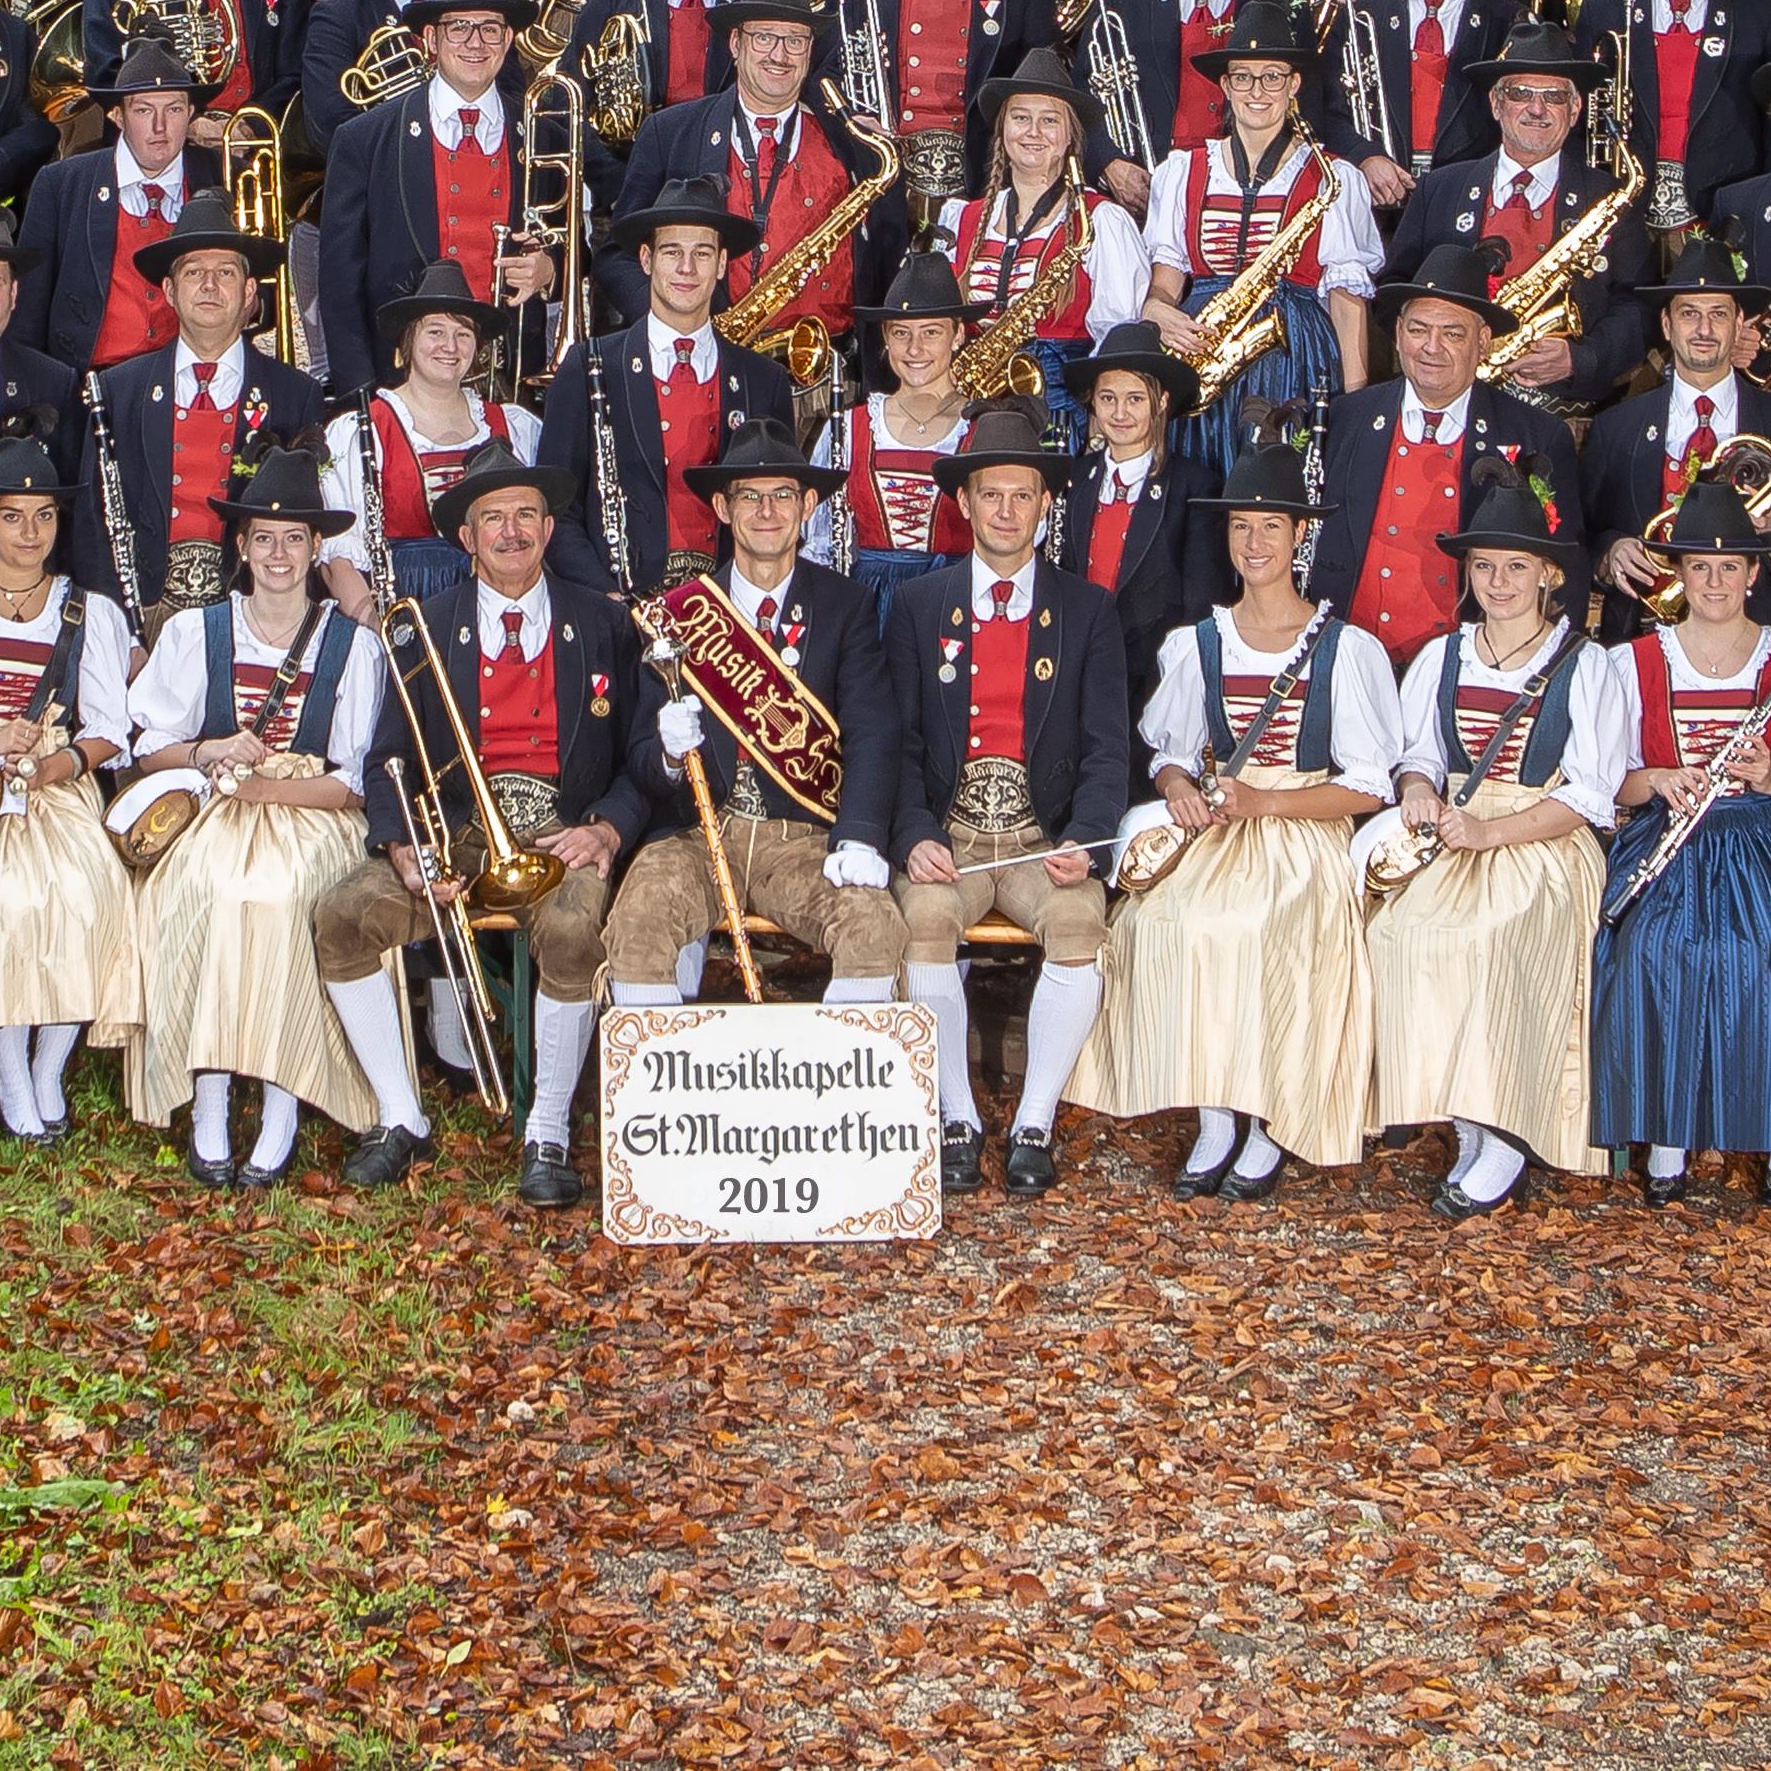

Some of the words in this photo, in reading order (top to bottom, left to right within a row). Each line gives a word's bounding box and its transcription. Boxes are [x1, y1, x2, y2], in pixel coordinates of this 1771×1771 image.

[675, 594, 768, 701] Musik
[642, 1047, 896, 1100] Musikkapelle
[718, 1177, 820, 1215] 2019
